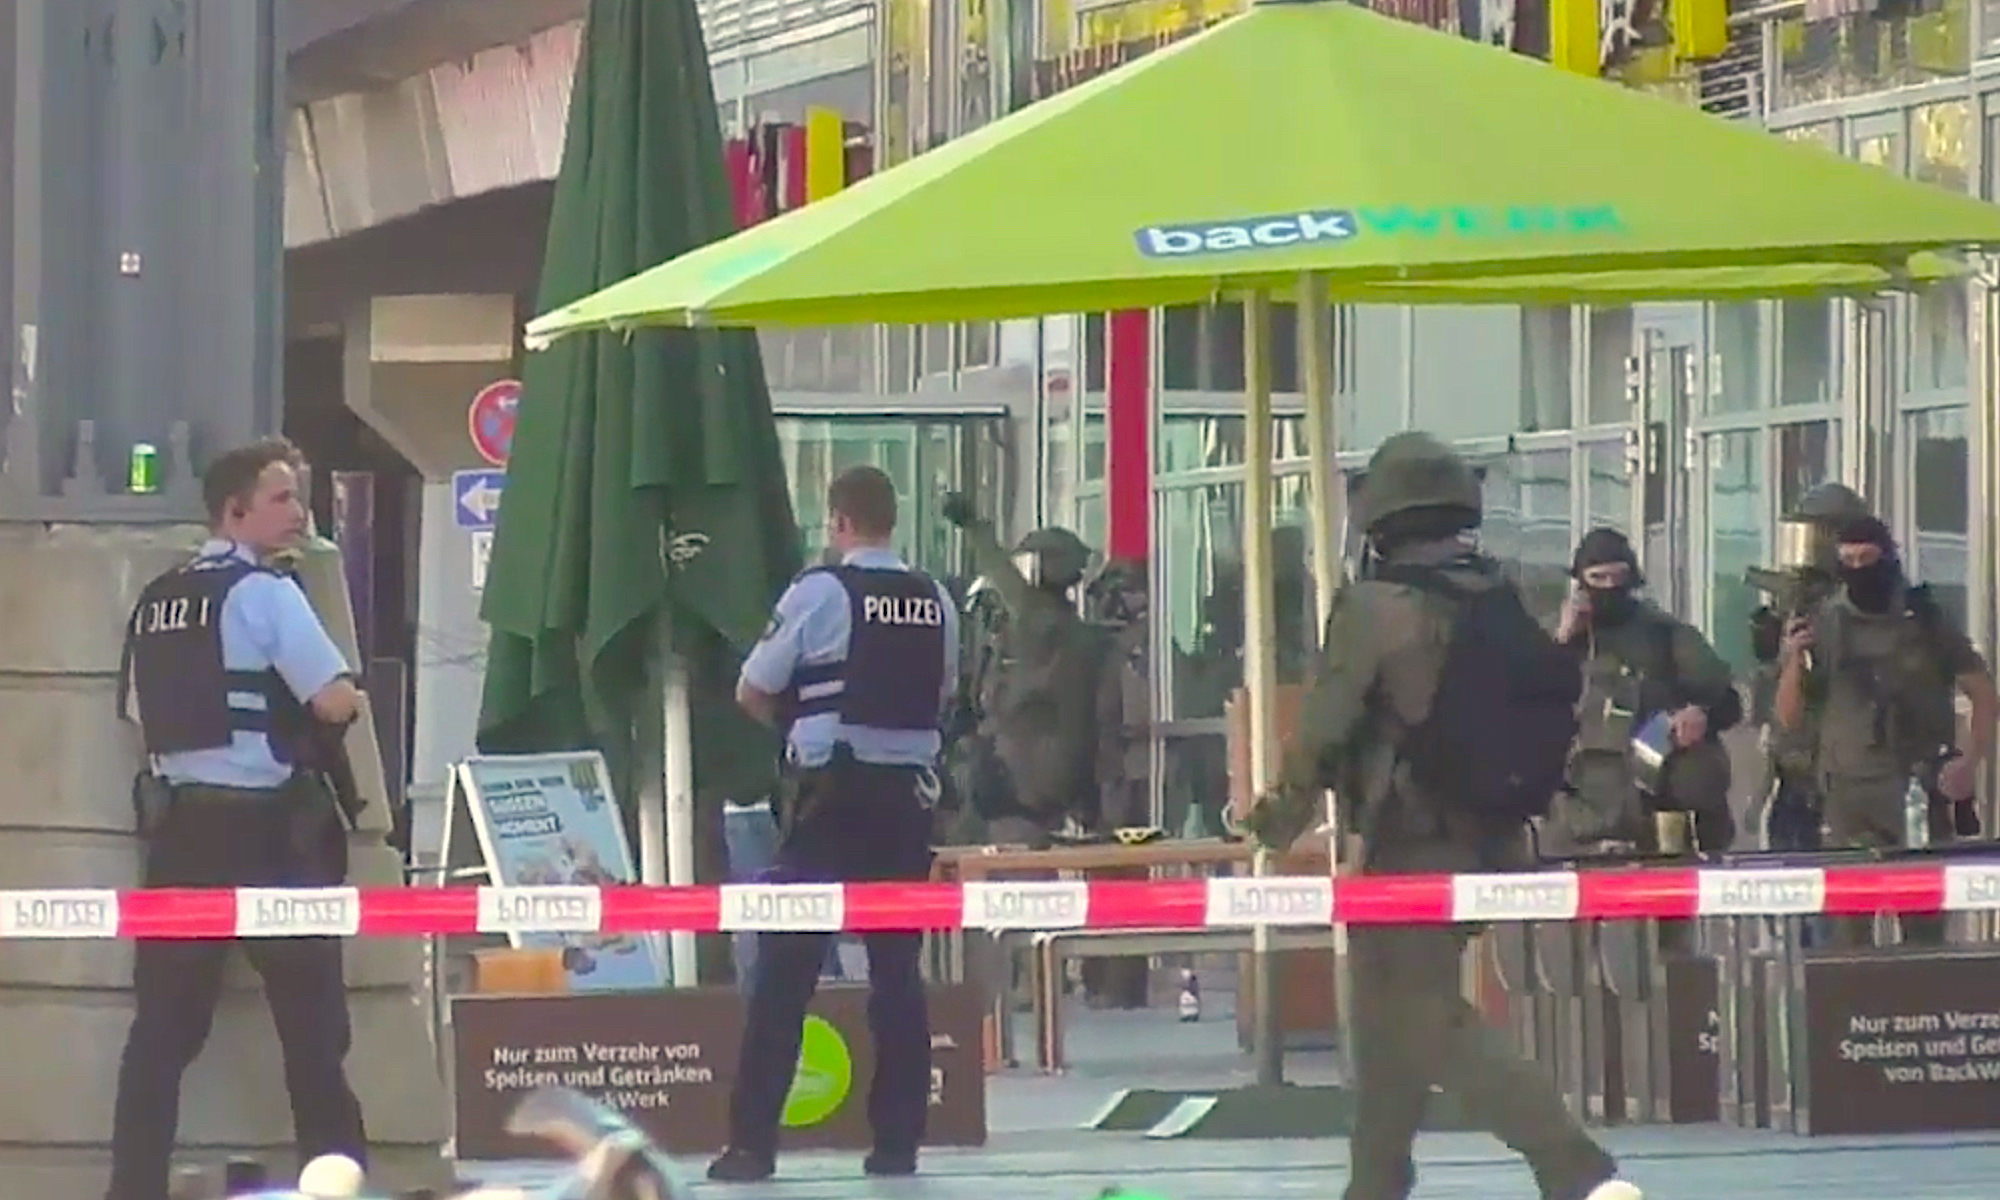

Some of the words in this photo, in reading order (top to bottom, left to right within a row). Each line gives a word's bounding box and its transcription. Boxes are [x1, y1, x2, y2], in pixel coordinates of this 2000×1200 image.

[1148, 213, 1350, 255] back
[864, 595, 942, 626] POLIZEI
[1850, 1015, 1889, 1033] Nur
[1894, 1014, 1940, 1032] zum
[493, 1046, 530, 1066] Nur
[534, 1045, 579, 1064] zum
[582, 1042, 661, 1063] Verzehr
[663, 1042, 701, 1060] von
[1839, 1038, 1919, 1063] Speisen
[1923, 1034, 1966, 1057] und
[484, 1067, 560, 1091] Speisen
[563, 1065, 606, 1087] und
[608, 1064, 714, 1087] Getränken
[1883, 1065, 1924, 1083] von
